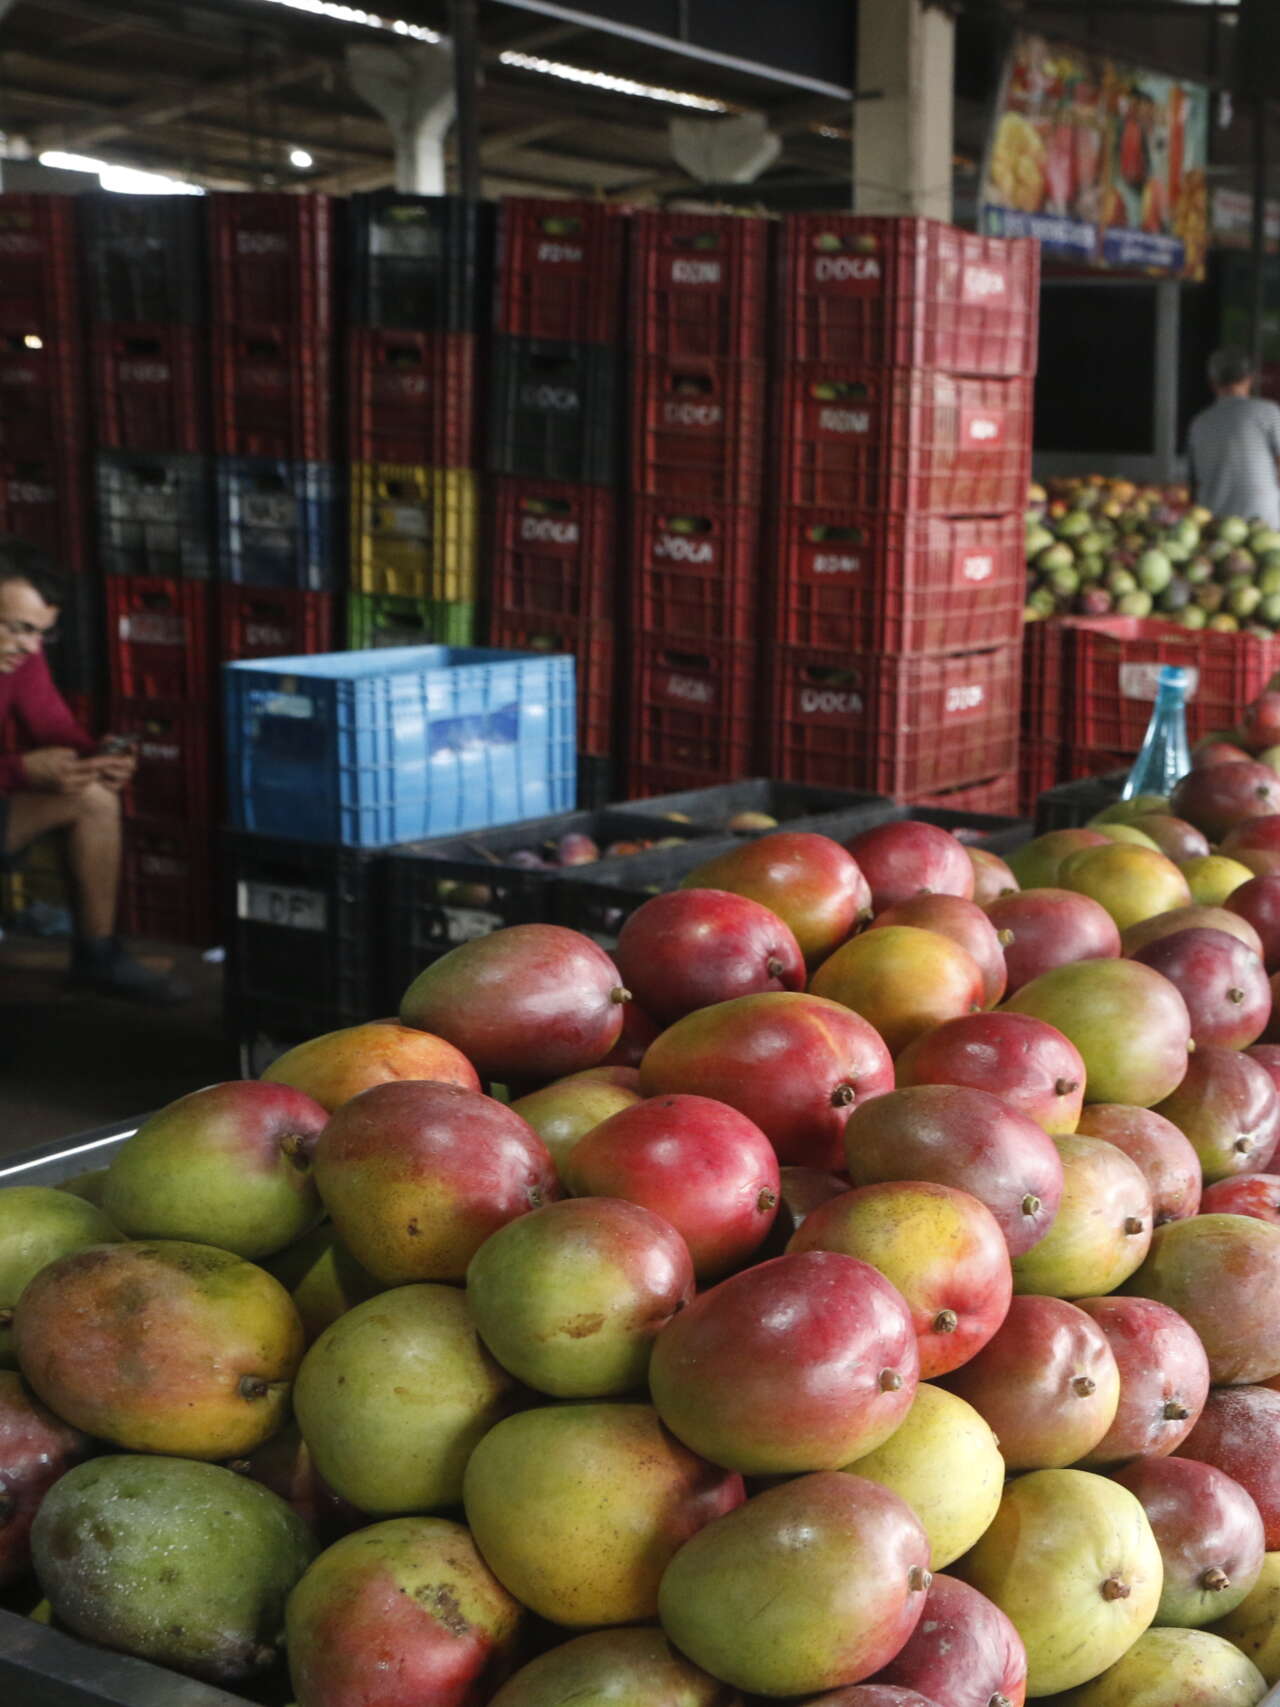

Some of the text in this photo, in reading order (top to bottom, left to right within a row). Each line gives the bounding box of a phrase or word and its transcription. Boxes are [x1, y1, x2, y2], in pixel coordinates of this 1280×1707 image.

[815, 257, 880, 281] DOCA
[520, 516, 580, 543] DOCA
[799, 688, 864, 714] DOCA
